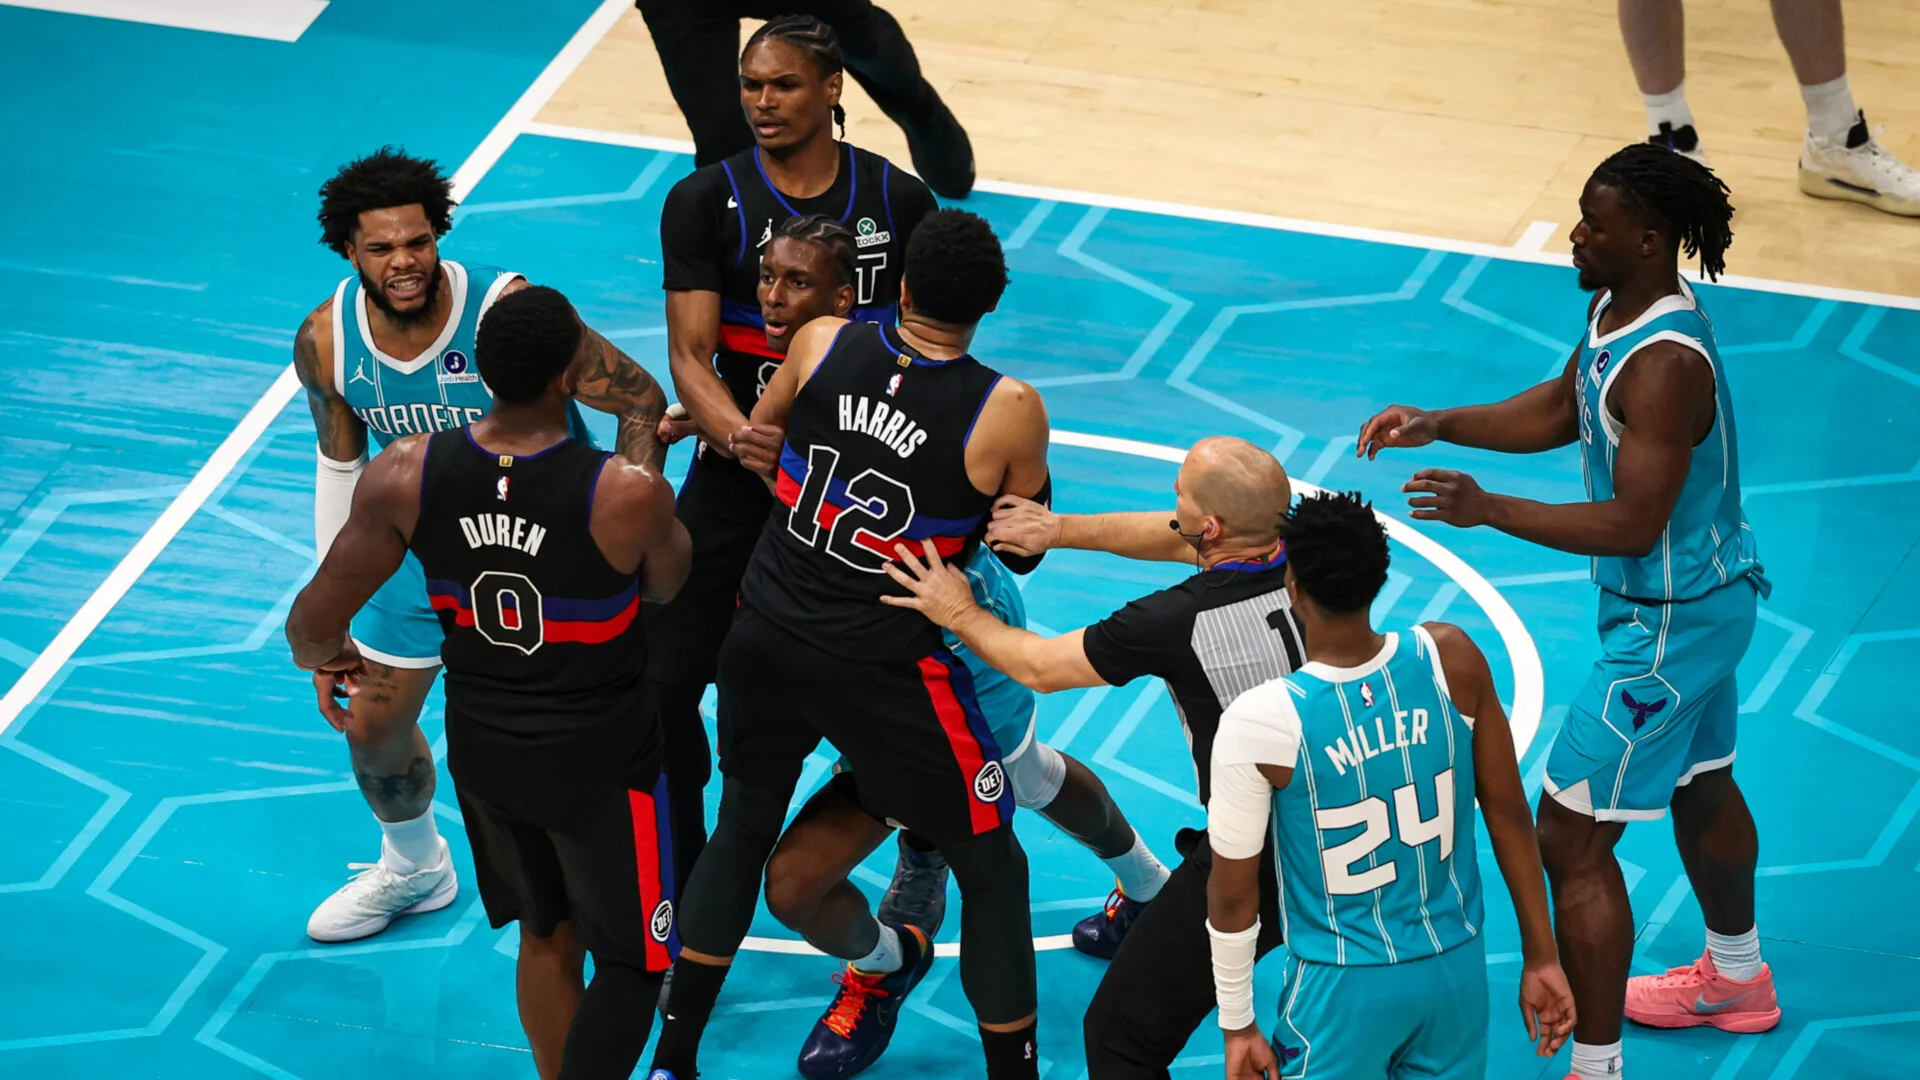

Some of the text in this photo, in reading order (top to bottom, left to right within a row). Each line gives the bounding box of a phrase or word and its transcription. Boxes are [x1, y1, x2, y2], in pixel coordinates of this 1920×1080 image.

[856, 233, 889, 247] tockX
[838, 394, 928, 459] HARRIS
[458, 513, 547, 557] DUREN
[787, 444, 916, 574] 12
[470, 570, 544, 656] 0
[1265, 607, 1307, 674] 1
[1324, 708, 1429, 777] MILLER
[1314, 766, 1456, 895] 24
